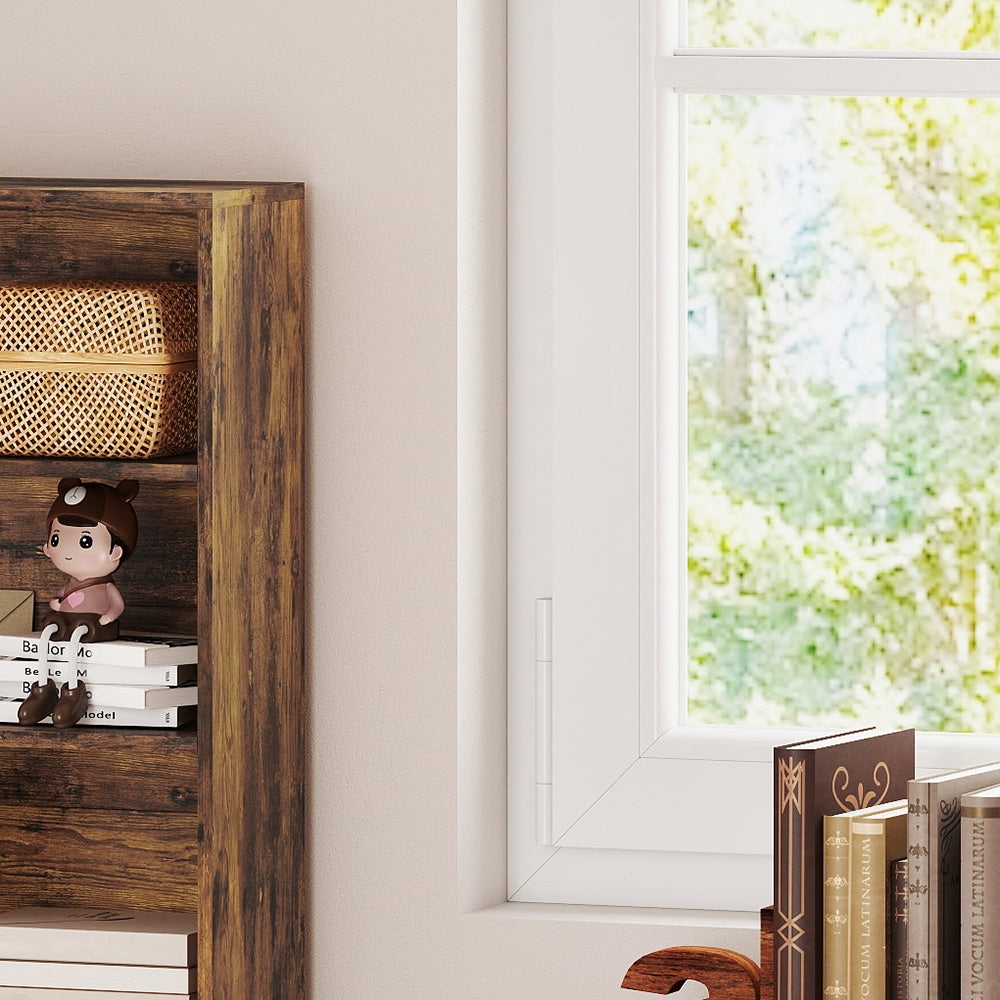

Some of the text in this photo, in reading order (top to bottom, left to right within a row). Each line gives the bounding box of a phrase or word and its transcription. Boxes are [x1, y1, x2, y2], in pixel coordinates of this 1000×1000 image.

[82, 711, 116, 721] odel
[861, 838, 872, 938] LATINARUM
[971, 821, 985, 918] LATINARUM
[971, 922, 984, 986] VOCUM
